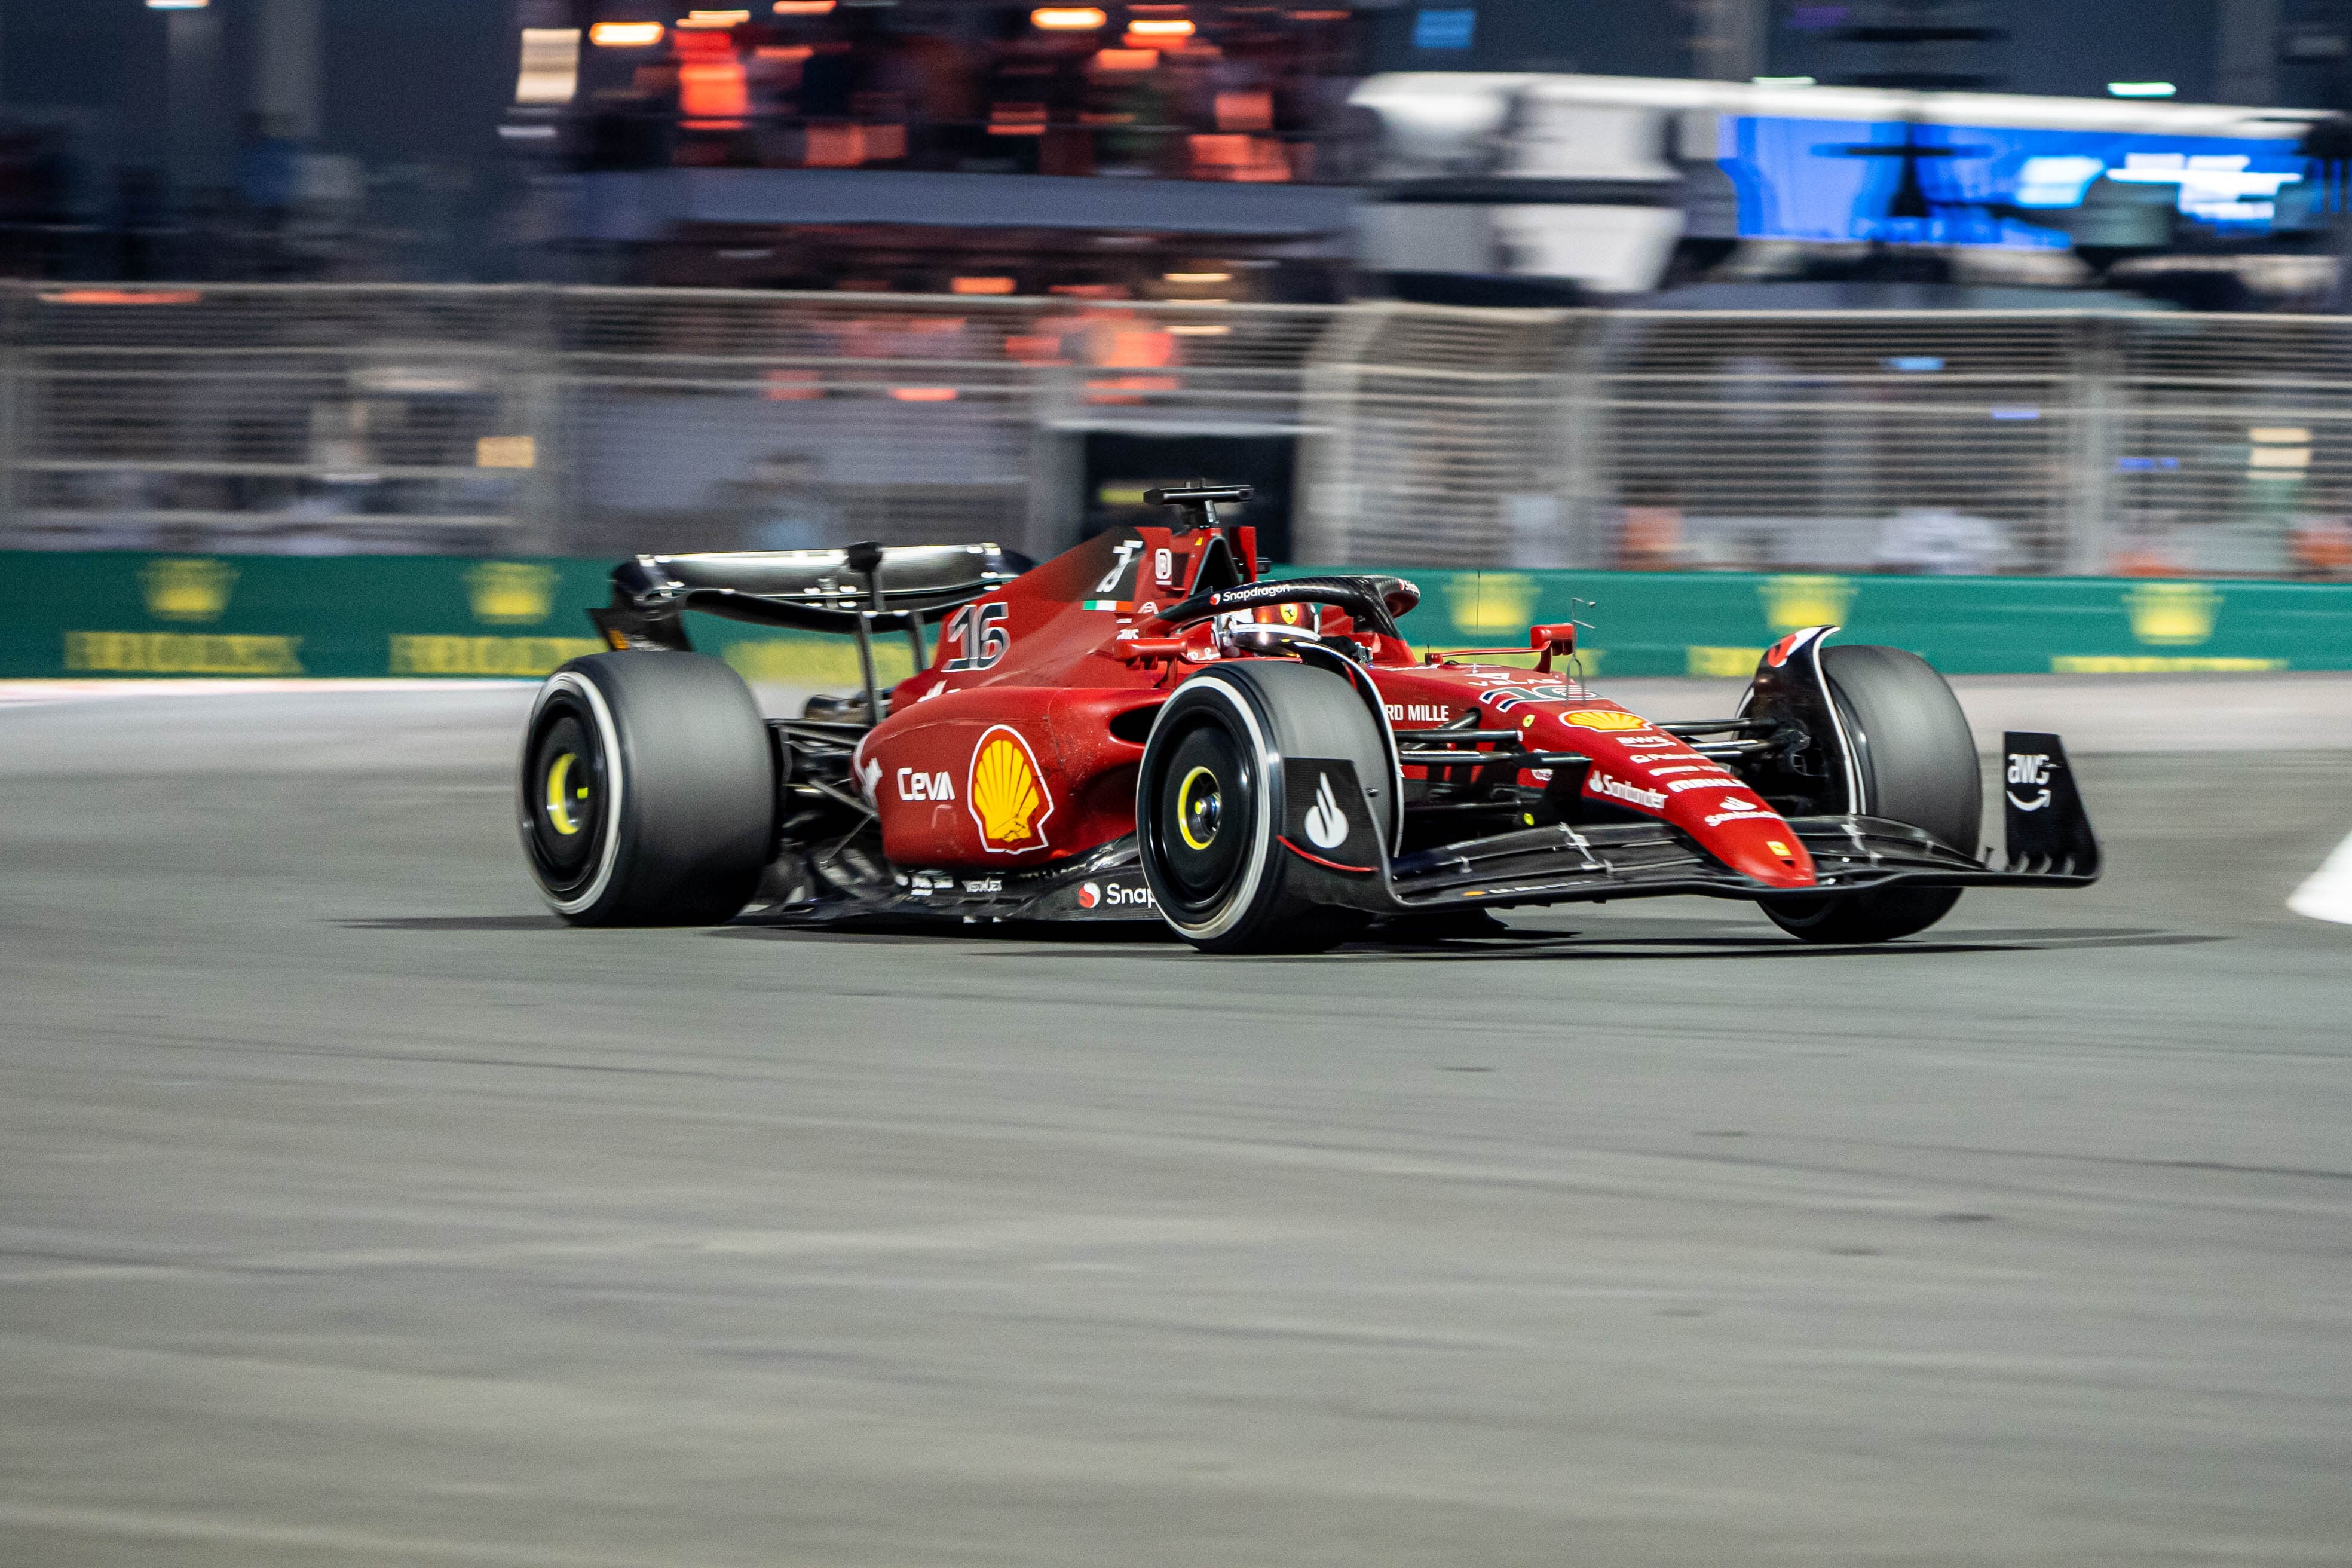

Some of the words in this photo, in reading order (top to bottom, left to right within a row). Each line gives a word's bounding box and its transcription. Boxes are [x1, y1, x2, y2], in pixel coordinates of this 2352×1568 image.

[1223, 584, 1291, 601] Snapdragon
[941, 602, 1011, 673] 16
[1407, 704, 1450, 721] MILLE
